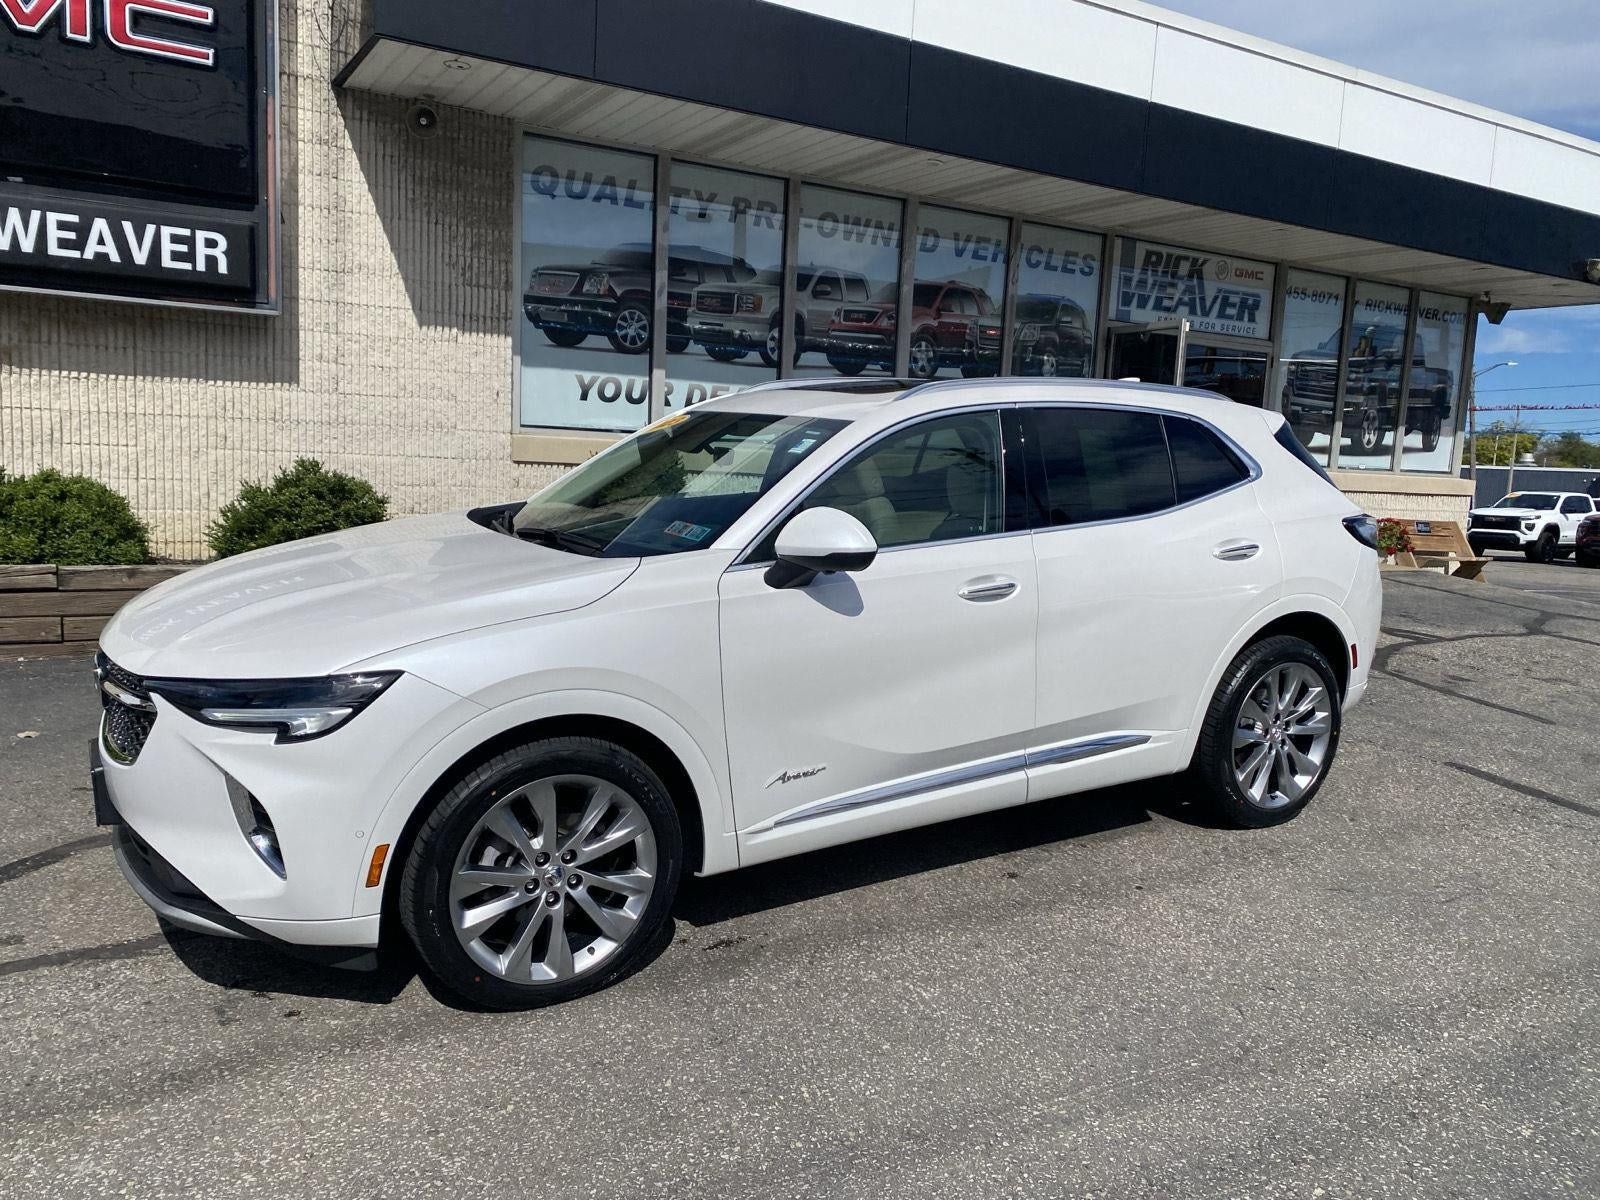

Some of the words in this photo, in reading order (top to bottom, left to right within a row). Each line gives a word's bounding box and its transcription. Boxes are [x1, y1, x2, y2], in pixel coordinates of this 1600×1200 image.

[529, 165, 718, 219] QUALTY
[728, 194, 940, 253] PR-OWND
[0, 207, 228, 274] WEAVER
[1140, 249, 1211, 280] RICK
[1234, 267, 1264, 281] GMC
[1120, 273, 1262, 323] WEAVER
[1199, 320, 1216, 331] FOR
[1220, 322, 1257, 335] SERVICE
